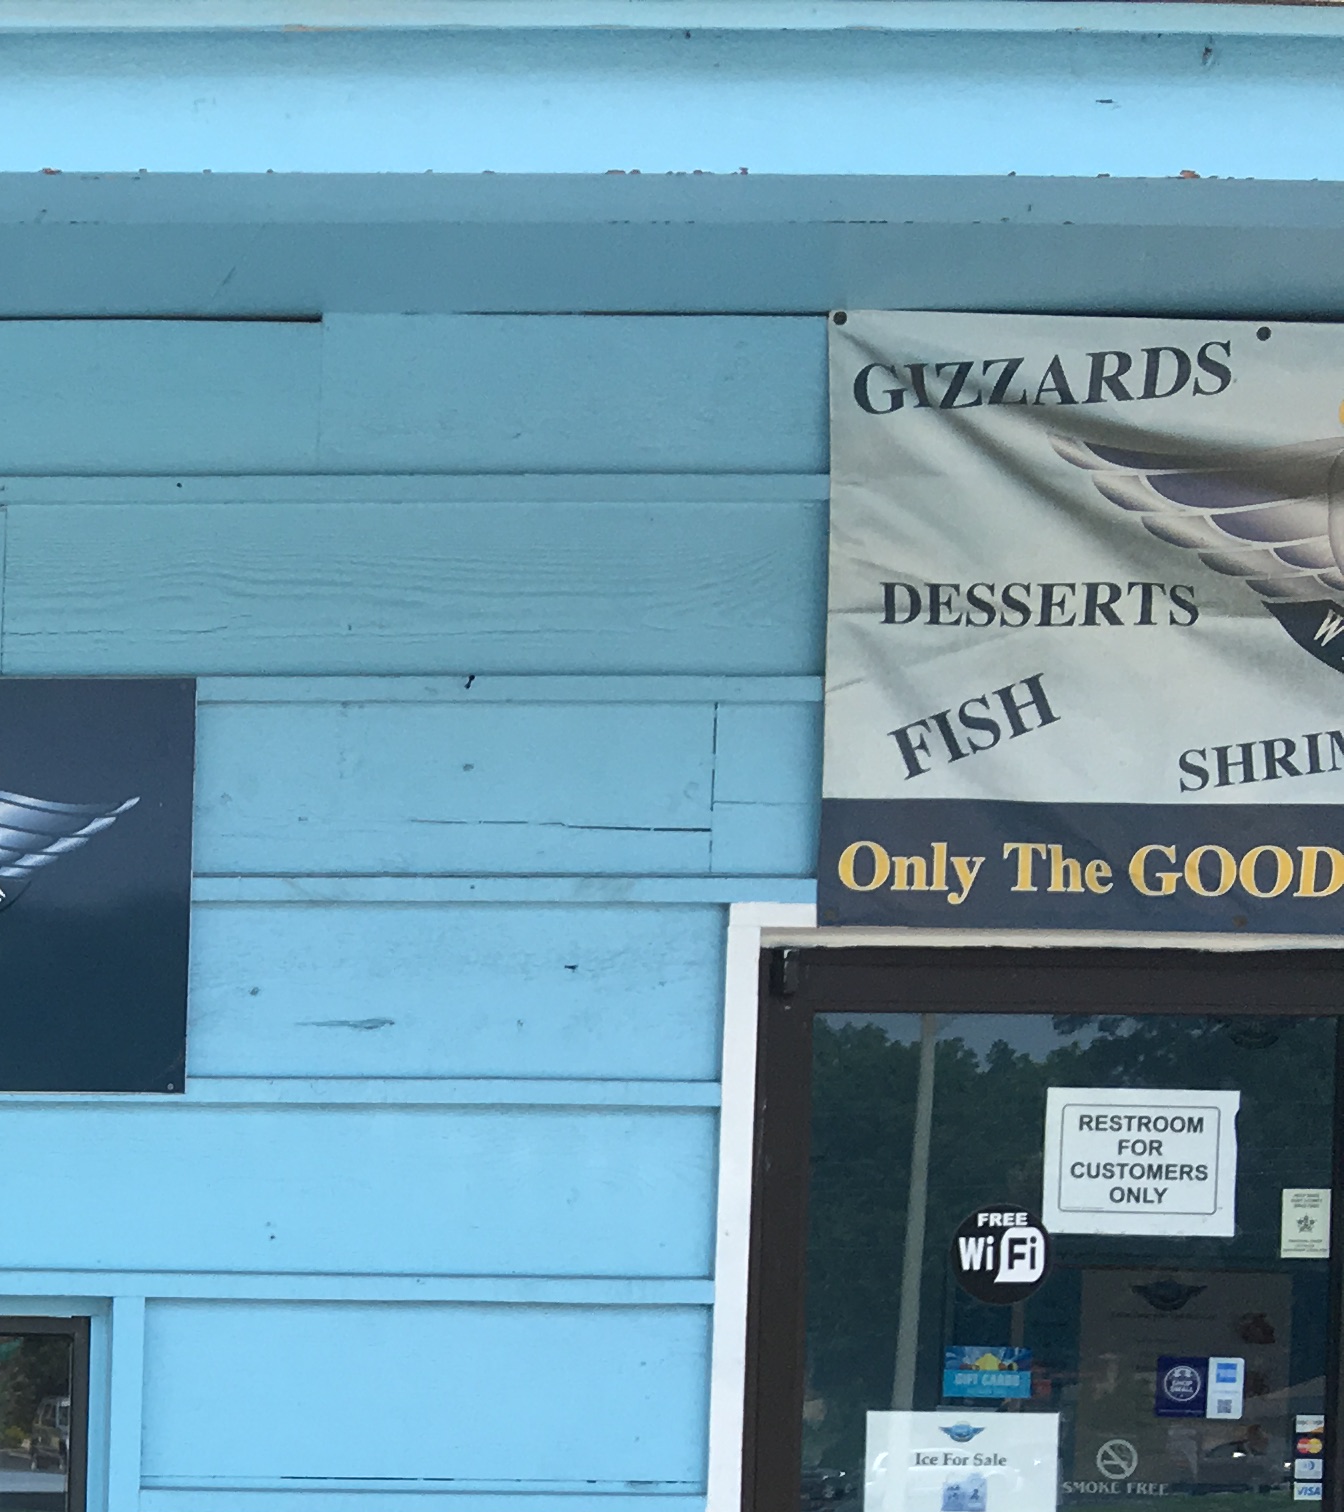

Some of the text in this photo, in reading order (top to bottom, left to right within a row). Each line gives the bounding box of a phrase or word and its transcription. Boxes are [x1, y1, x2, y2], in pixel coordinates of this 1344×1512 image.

[852, 340, 1234, 415] GIZZARDS
[879, 581, 1201, 628] DESSERTS
[887, 672, 1062, 781] FISH
[837, 840, 1344, 905] Only The GOOD
[1078, 1114, 1205, 1134] RESTROOM
[1117, 1138, 1163, 1157] FOR
[1070, 1161, 1209, 1182] CUSTOMERS
[1109, 1186, 1169, 1204] ONLY
[977, 1212, 1028, 1228] FREE
[914, 1452, 1008, 1467] Ice For Sale
[1062, 1481, 1169, 1496] SMOKE FREE
[1298, 1486, 1321, 1496] VISA
